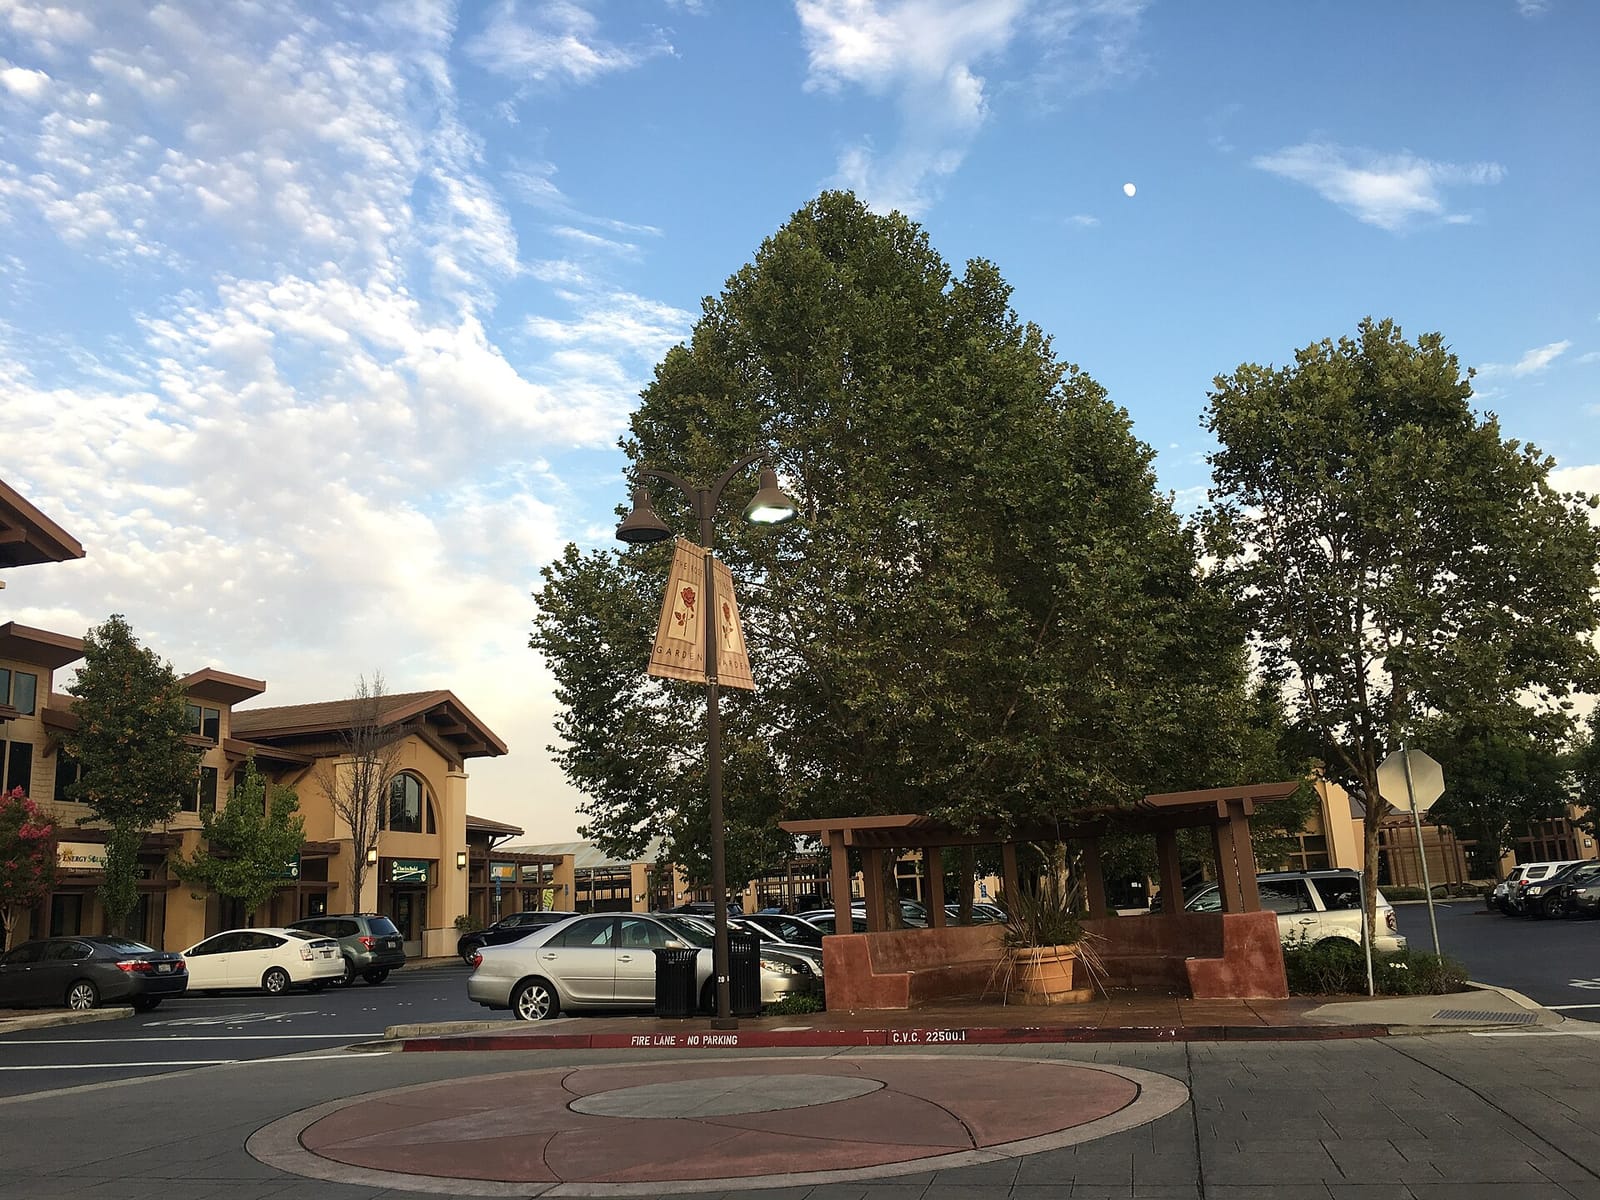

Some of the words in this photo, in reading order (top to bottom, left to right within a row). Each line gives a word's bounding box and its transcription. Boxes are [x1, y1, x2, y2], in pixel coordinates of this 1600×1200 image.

[656, 646, 703, 661] GARDEN
[630, 1035, 651, 1046] FIRE
[653, 1035, 676, 1045] LANE
[687, 1034, 700, 1045] NO
[702, 1034, 738, 1045] PARKING
[893, 1032, 921, 1043] C.V.C.
